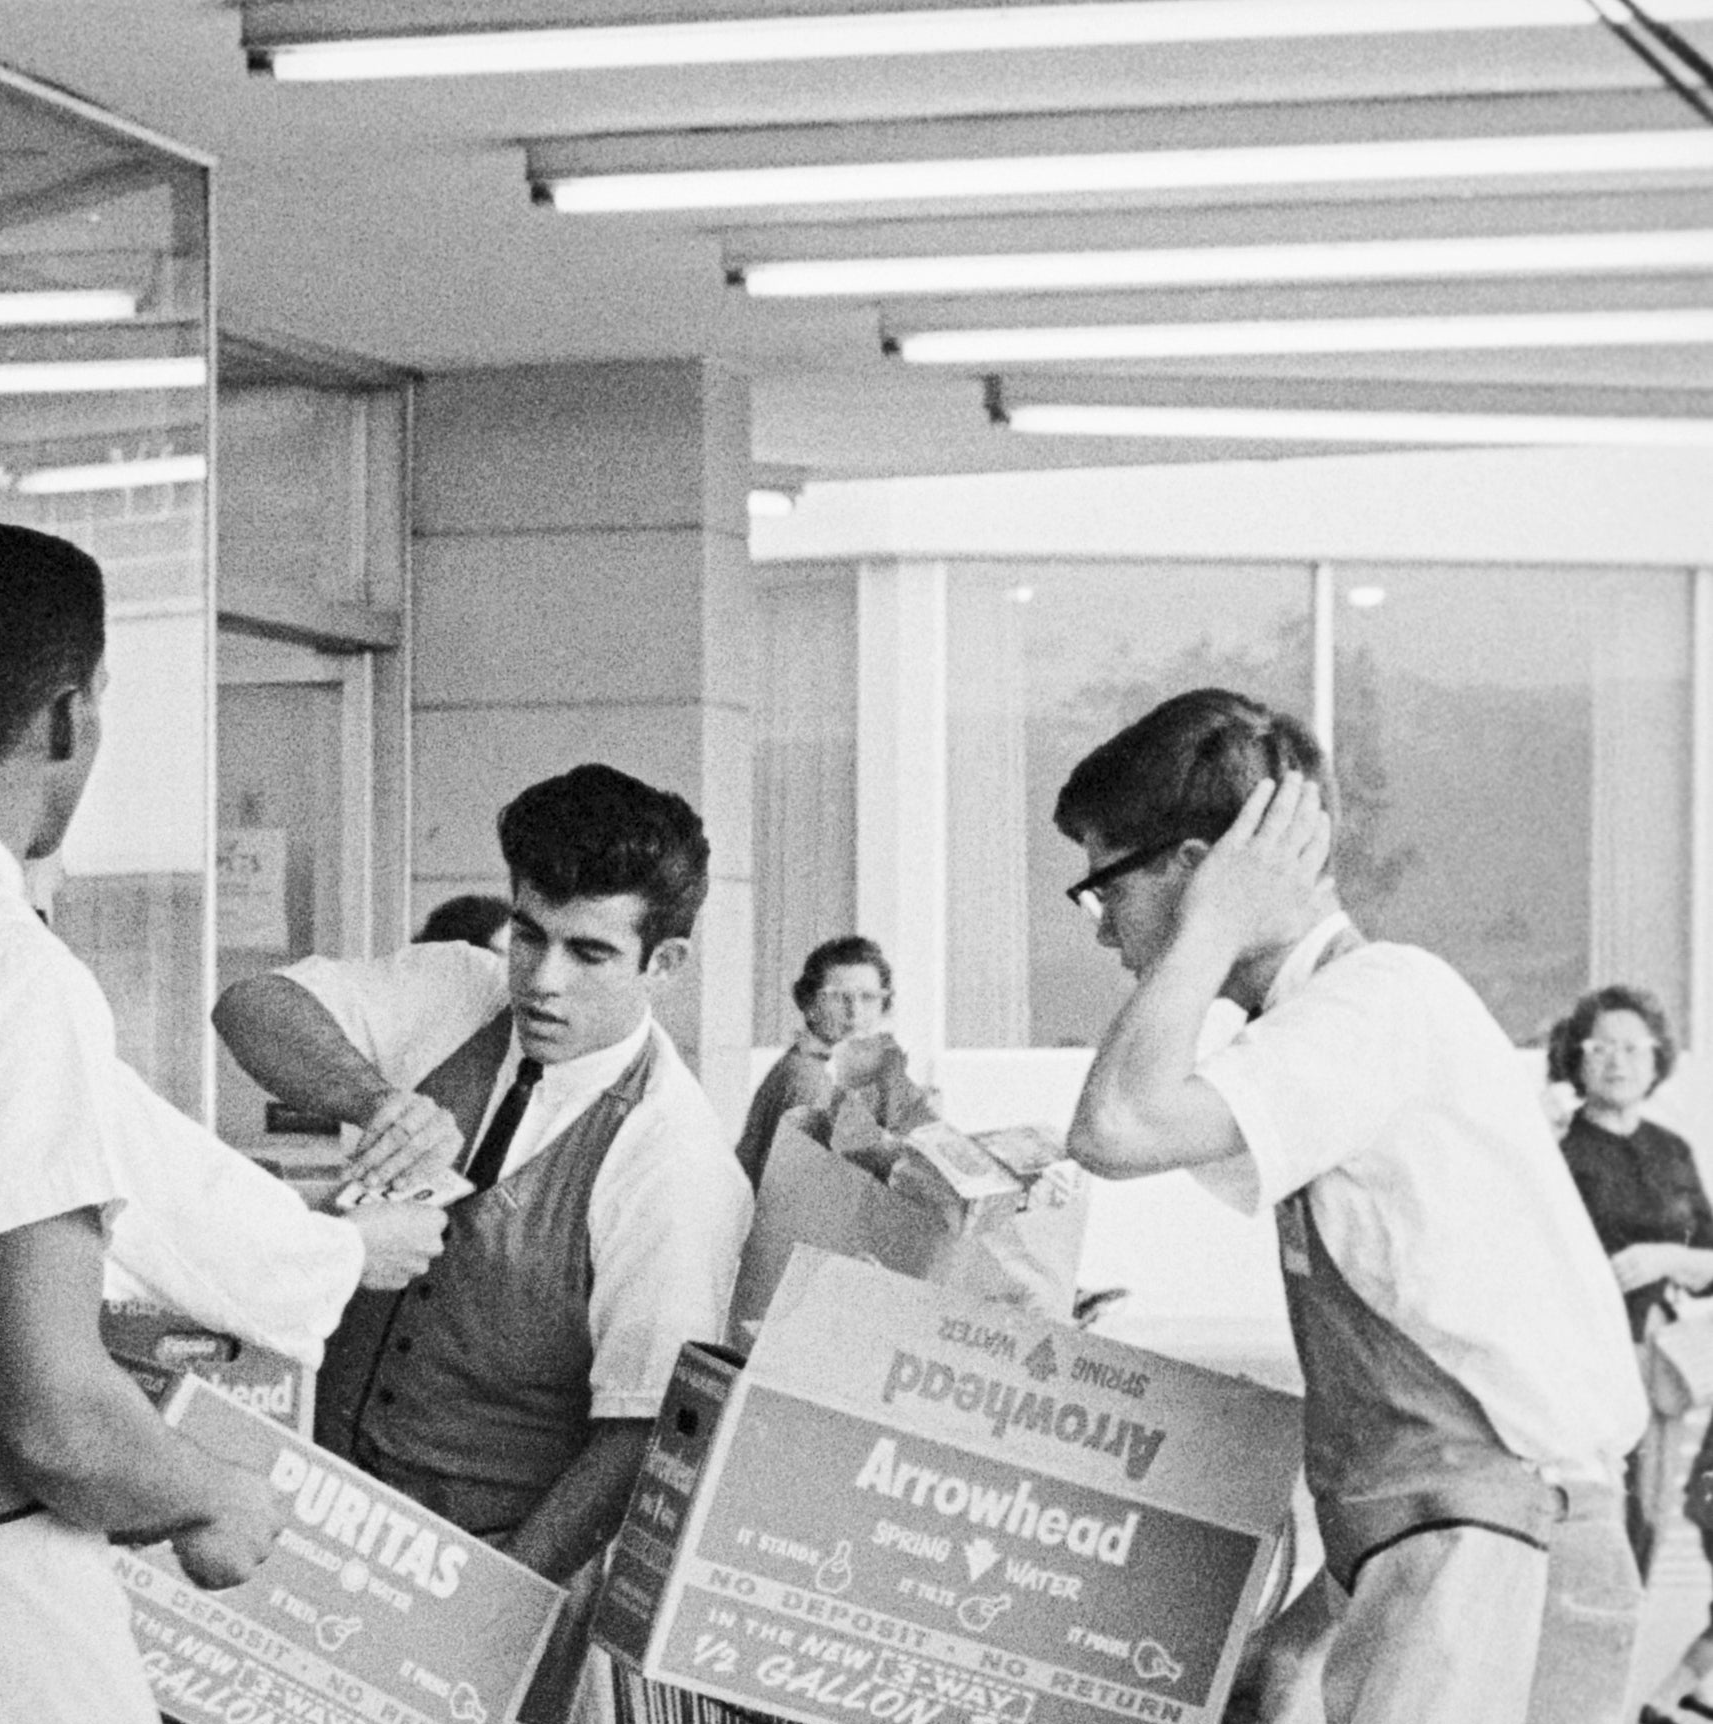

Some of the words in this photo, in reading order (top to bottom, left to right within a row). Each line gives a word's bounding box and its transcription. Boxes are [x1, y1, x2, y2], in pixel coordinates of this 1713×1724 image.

[937, 1316, 1017, 1362] WATER
[1071, 1356, 1151, 1400] SPRING
[882, 1348, 1167, 1483] Arrowhead
[269, 1449, 469, 1599] PURITAS
[855, 1436, 1142, 1567] Arrowhead
[112, 1557, 153, 1588] NO
[872, 1519, 952, 1564] SPRING
[1004, 1556, 1083, 1603] WATER
[177, 1635, 238, 1676] NEW
[693, 1633, 741, 1674] 1/2
[707, 1606, 738, 1629] IN
[744, 1617, 796, 1647] THE
[798, 1635, 875, 1671] NEW
[893, 1661, 1015, 1713] 3-WAY
[710, 1568, 757, 1597] NO
[781, 1590, 927, 1648] DEPOSIT
[978, 1650, 1027, 1678] NO
